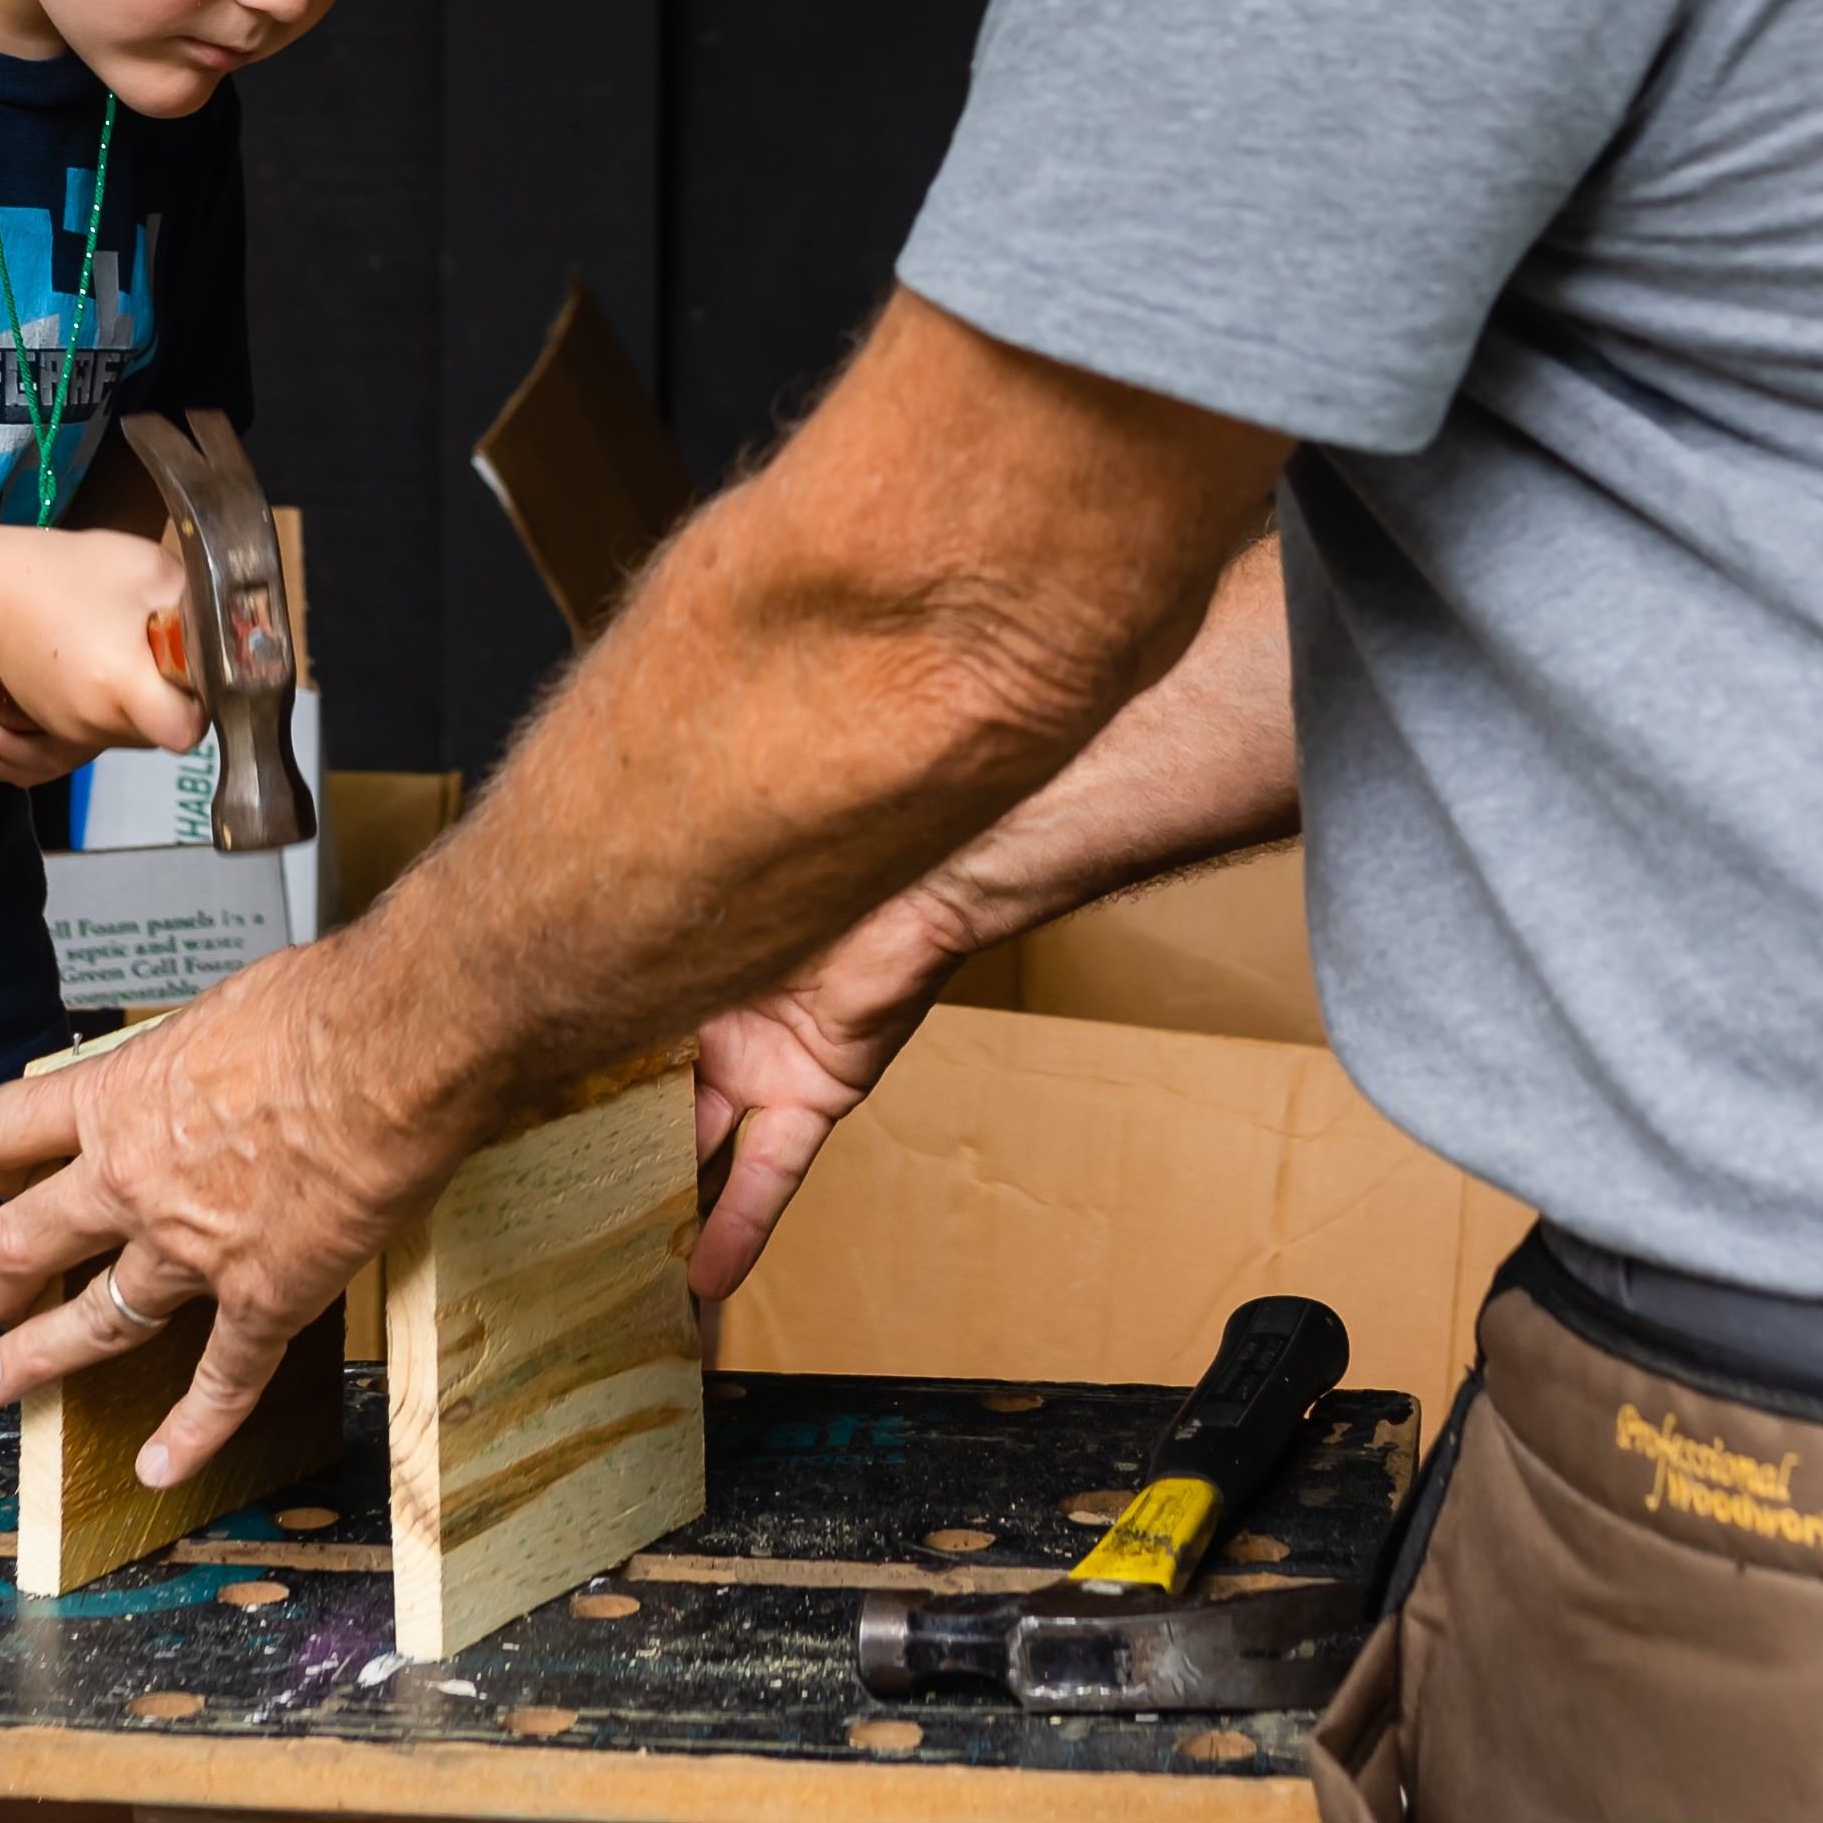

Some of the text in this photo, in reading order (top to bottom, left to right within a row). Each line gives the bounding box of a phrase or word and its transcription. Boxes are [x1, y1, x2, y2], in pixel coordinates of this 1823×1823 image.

[176, 742, 214, 845] HABLE
[78, 919, 139, 937] Foam
[134, 935, 178, 956] and
[129, 957, 178, 978] Cell
[1615, 1403, 1802, 1512] Professional
